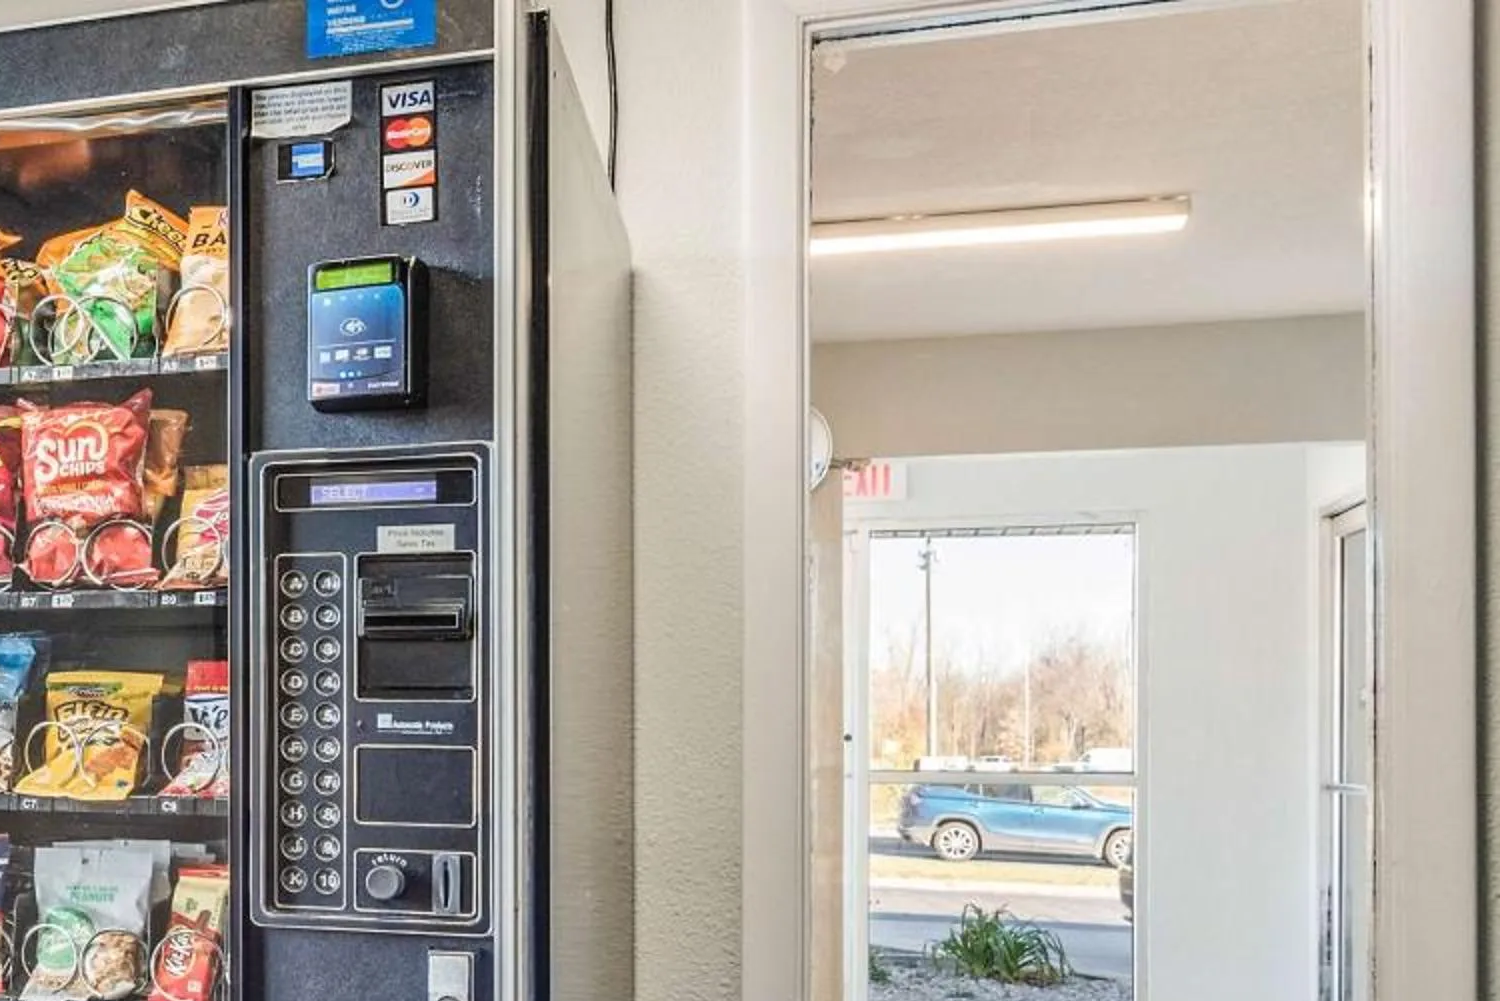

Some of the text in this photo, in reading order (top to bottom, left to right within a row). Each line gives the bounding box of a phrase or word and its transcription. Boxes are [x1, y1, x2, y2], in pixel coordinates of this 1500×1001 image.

[388, 89, 432, 109] VISA
[386, 159, 433, 173] DISCOVER
[34, 434, 107, 482] Sun
[61, 460, 106, 477] CHIPS
[371, 853, 408, 868] return
